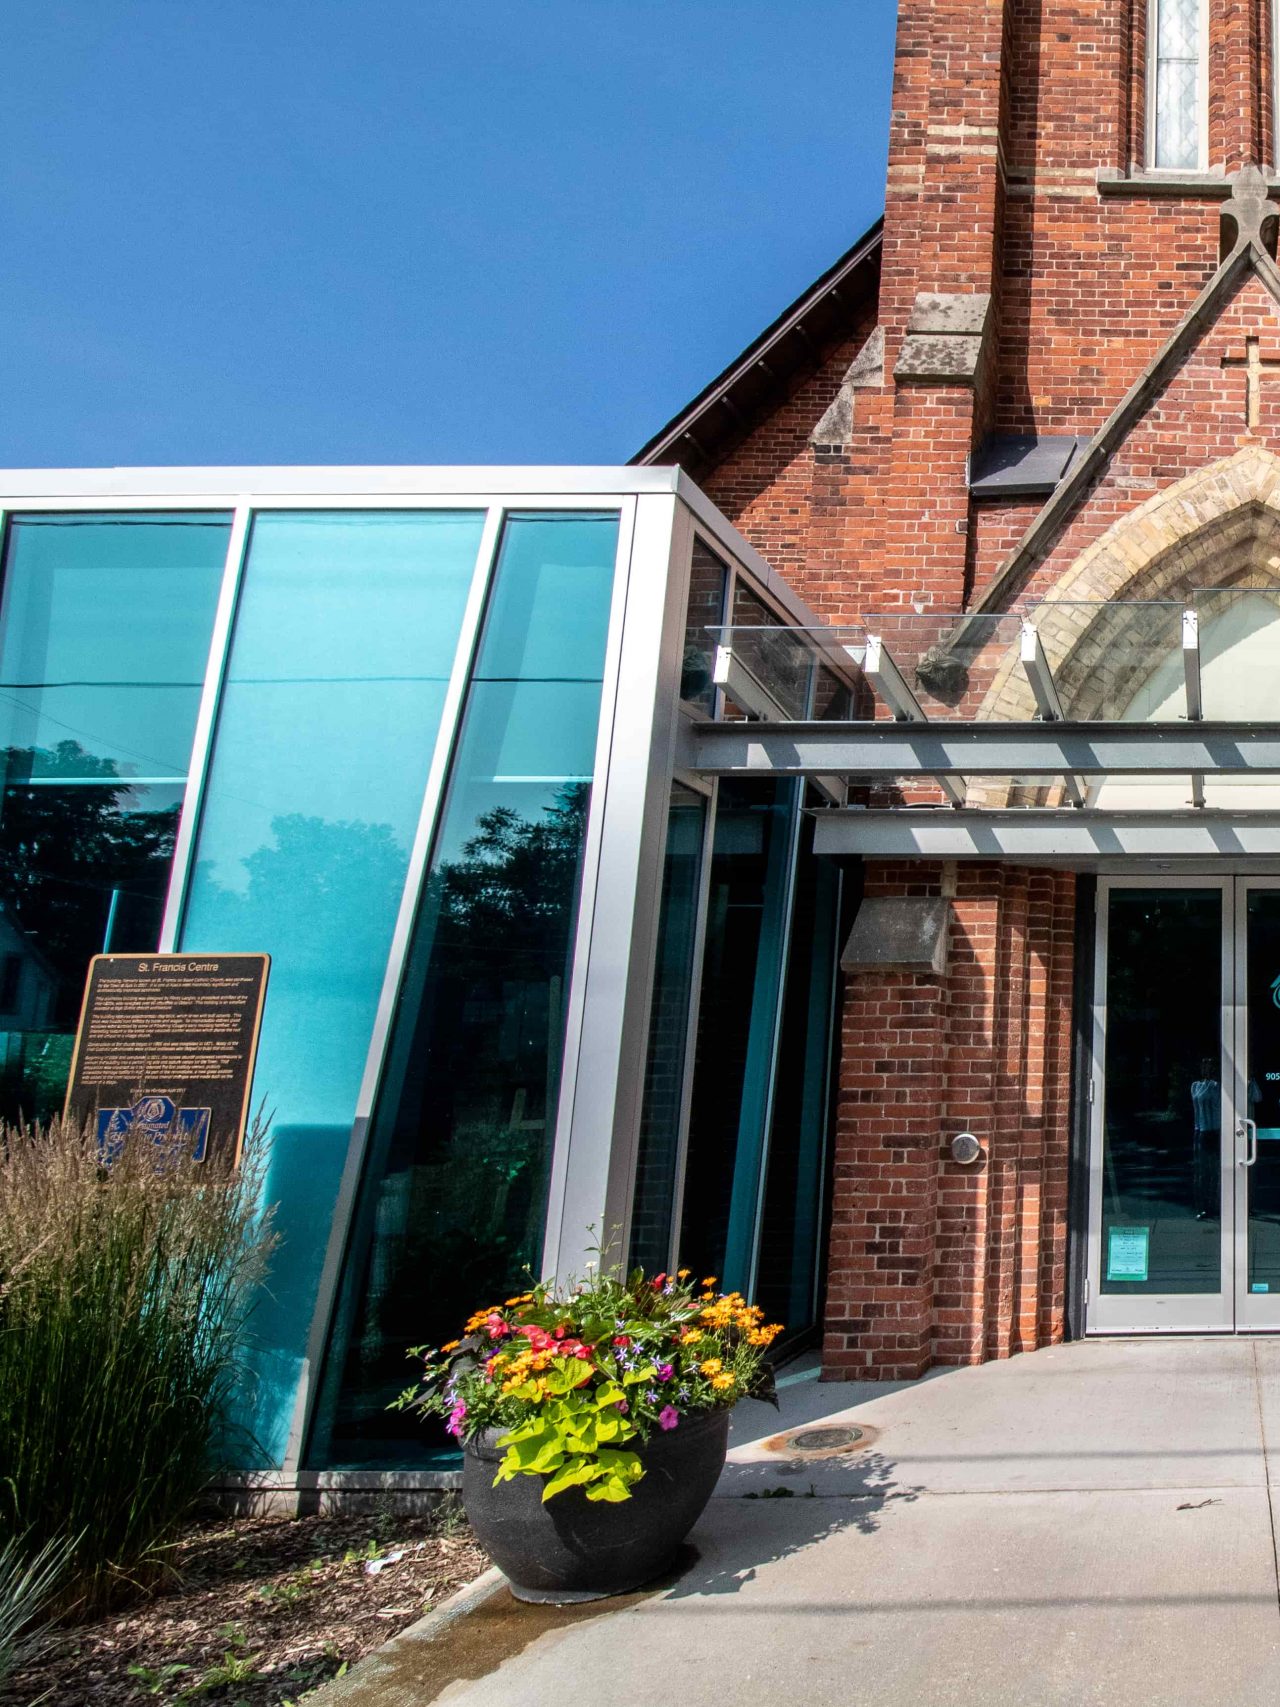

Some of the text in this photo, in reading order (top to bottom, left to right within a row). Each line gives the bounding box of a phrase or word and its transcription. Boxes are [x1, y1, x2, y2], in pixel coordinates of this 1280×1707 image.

[137, 962, 219, 972] St. Francis Centre
